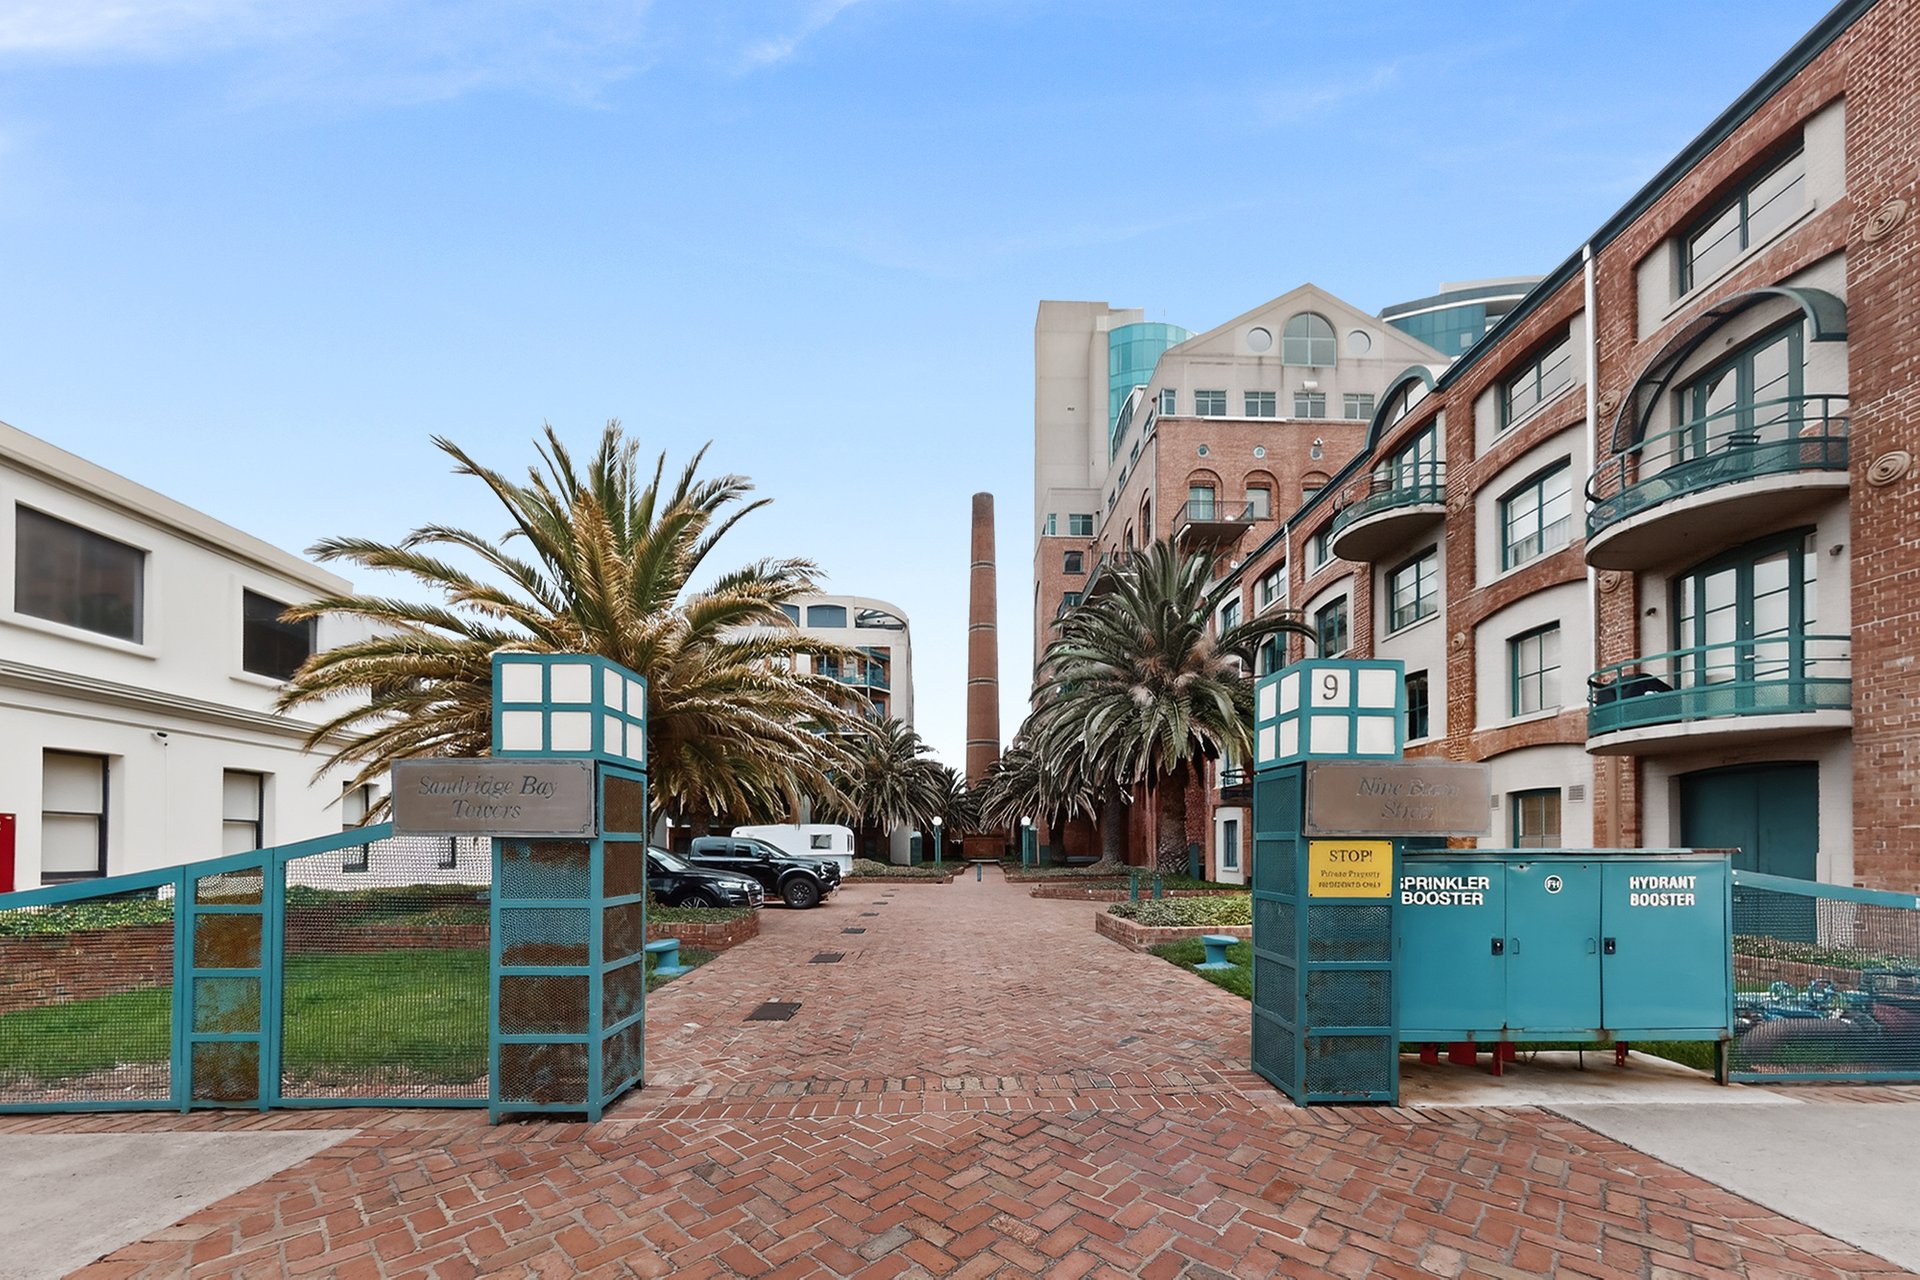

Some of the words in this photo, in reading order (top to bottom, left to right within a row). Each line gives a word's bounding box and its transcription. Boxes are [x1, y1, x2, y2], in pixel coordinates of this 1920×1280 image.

[1322, 674, 1339, 700] 9
[417, 775, 514, 799] Sandridge
[519, 775, 558, 799] Bay
[452, 799, 521, 819] Towers
[1329, 849, 1373, 863] STOP!
[1629, 876, 1697, 890] HYDRANT
[1401, 891, 1485, 905] BOOSTER
[1630, 892, 1696, 906] BOOSTER
